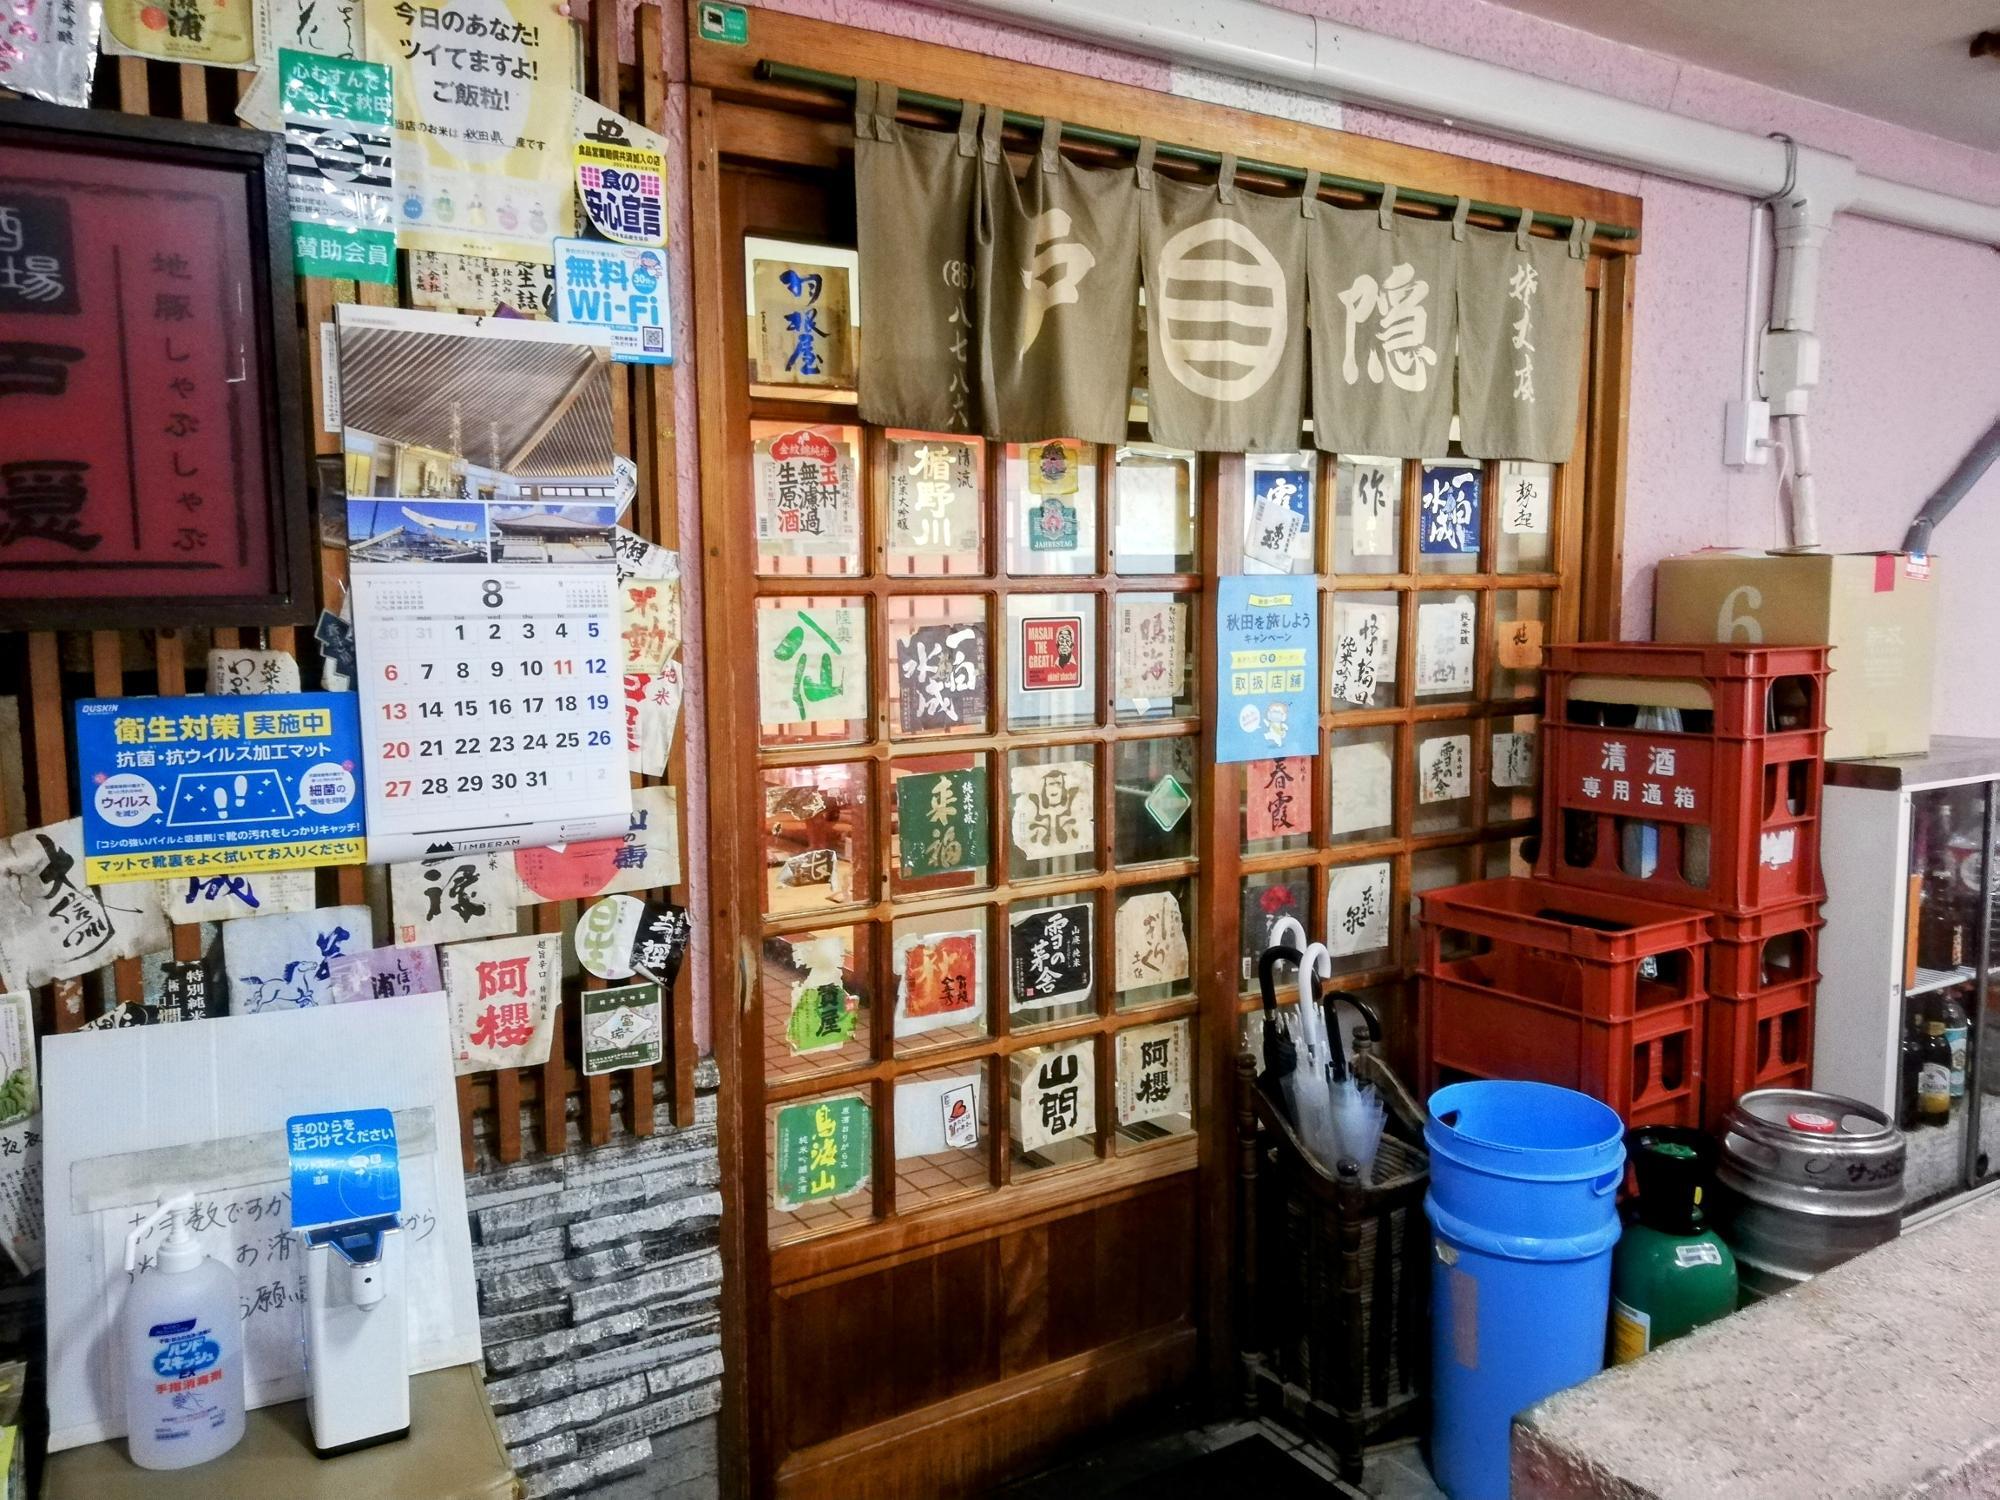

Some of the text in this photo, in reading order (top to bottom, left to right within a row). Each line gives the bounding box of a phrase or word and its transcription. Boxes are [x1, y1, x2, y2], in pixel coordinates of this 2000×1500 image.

[394, 2, 539, 47] 今日のあなた!
[400, 39, 538, 80] ツイてますよ!
[433, 78, 510, 111] ご飯粒!
[395, 119, 458, 138] 当店のお米は
[516, 137, 546, 151] 産です
[601, 169, 640, 194] 食の
[584, 188, 661, 237] 安心宣言
[296, 236, 389, 267] 賛助会員
[566, 255, 630, 291] 無料
[567, 289, 659, 325] Wi-Fi
[1019, 208, 1096, 362] 戸
[1337, 262, 1438, 393] 隠
[957, 449, 973, 489] 清流
[776, 462, 799, 533] 生原酒
[798, 461, 824, 536] 無濾過
[818, 465, 840, 509] 玉村
[908, 445, 956, 546] 楯野川
[481, 579, 504, 608] 8
[1226, 612, 1310, 631] 秋田を旅しよう
[1717, 585, 1765, 643] 6
[455, 625, 464, 640] 1
[489, 624, 501, 639] 2
[523, 623, 535, 638] 3
[555, 623, 568, 638] 4
[588, 623, 599, 637] 5
[1034, 641, 1048, 654] THE
[1244, 633, 1292, 643] キャンペーン
[384, 659, 607, 680] 6 7 8 9 10 11 12
[1233, 674, 1302, 690] 取扱店舗
[82, 704, 119, 713] DUSKIN
[382, 695, 609, 720] 13 14 15 16 17 18 19
[114, 712, 324, 744] 衛生対策 実施中
[383, 731, 611, 759] 20 21 22 23 24 25 26
[116, 743, 331, 768] 抗菌・抗ウイルス加工マット
[1601, 741, 1676, 777] 清酒
[309, 783, 346, 797] 細菌の
[385, 781, 411, 797] 27
[422, 779, 448, 795] 28
[457, 776, 483, 792] 29
[491, 774, 517, 789] 30
[526, 772, 547, 787] 31
[1264, 758, 1295, 831] 春霞
[1582, 775, 1695, 810] 専用通箱
[101, 795, 150, 809] ウイルス
[926, 775, 962, 868] 来福
[97, 842, 359, 872] マットで靴裏をよく拭いてお入りください
[1044, 913, 1069, 966] 雪の
[1030, 939, 1063, 994] 茅舎
[186, 969, 207, 1020] 特別純米
[470, 956, 535, 1050] 阿櫻
[1136, 1038, 1171, 1104] 阿櫻
[1038, 1054, 1078, 1135] 山間
[291, 1118, 355, 1137] 手のひらを
[292, 1127, 394, 1151] 近づけてください
[810, 1104, 837, 1194] 鳥海山
[179, 1369, 196, 1379] EX
